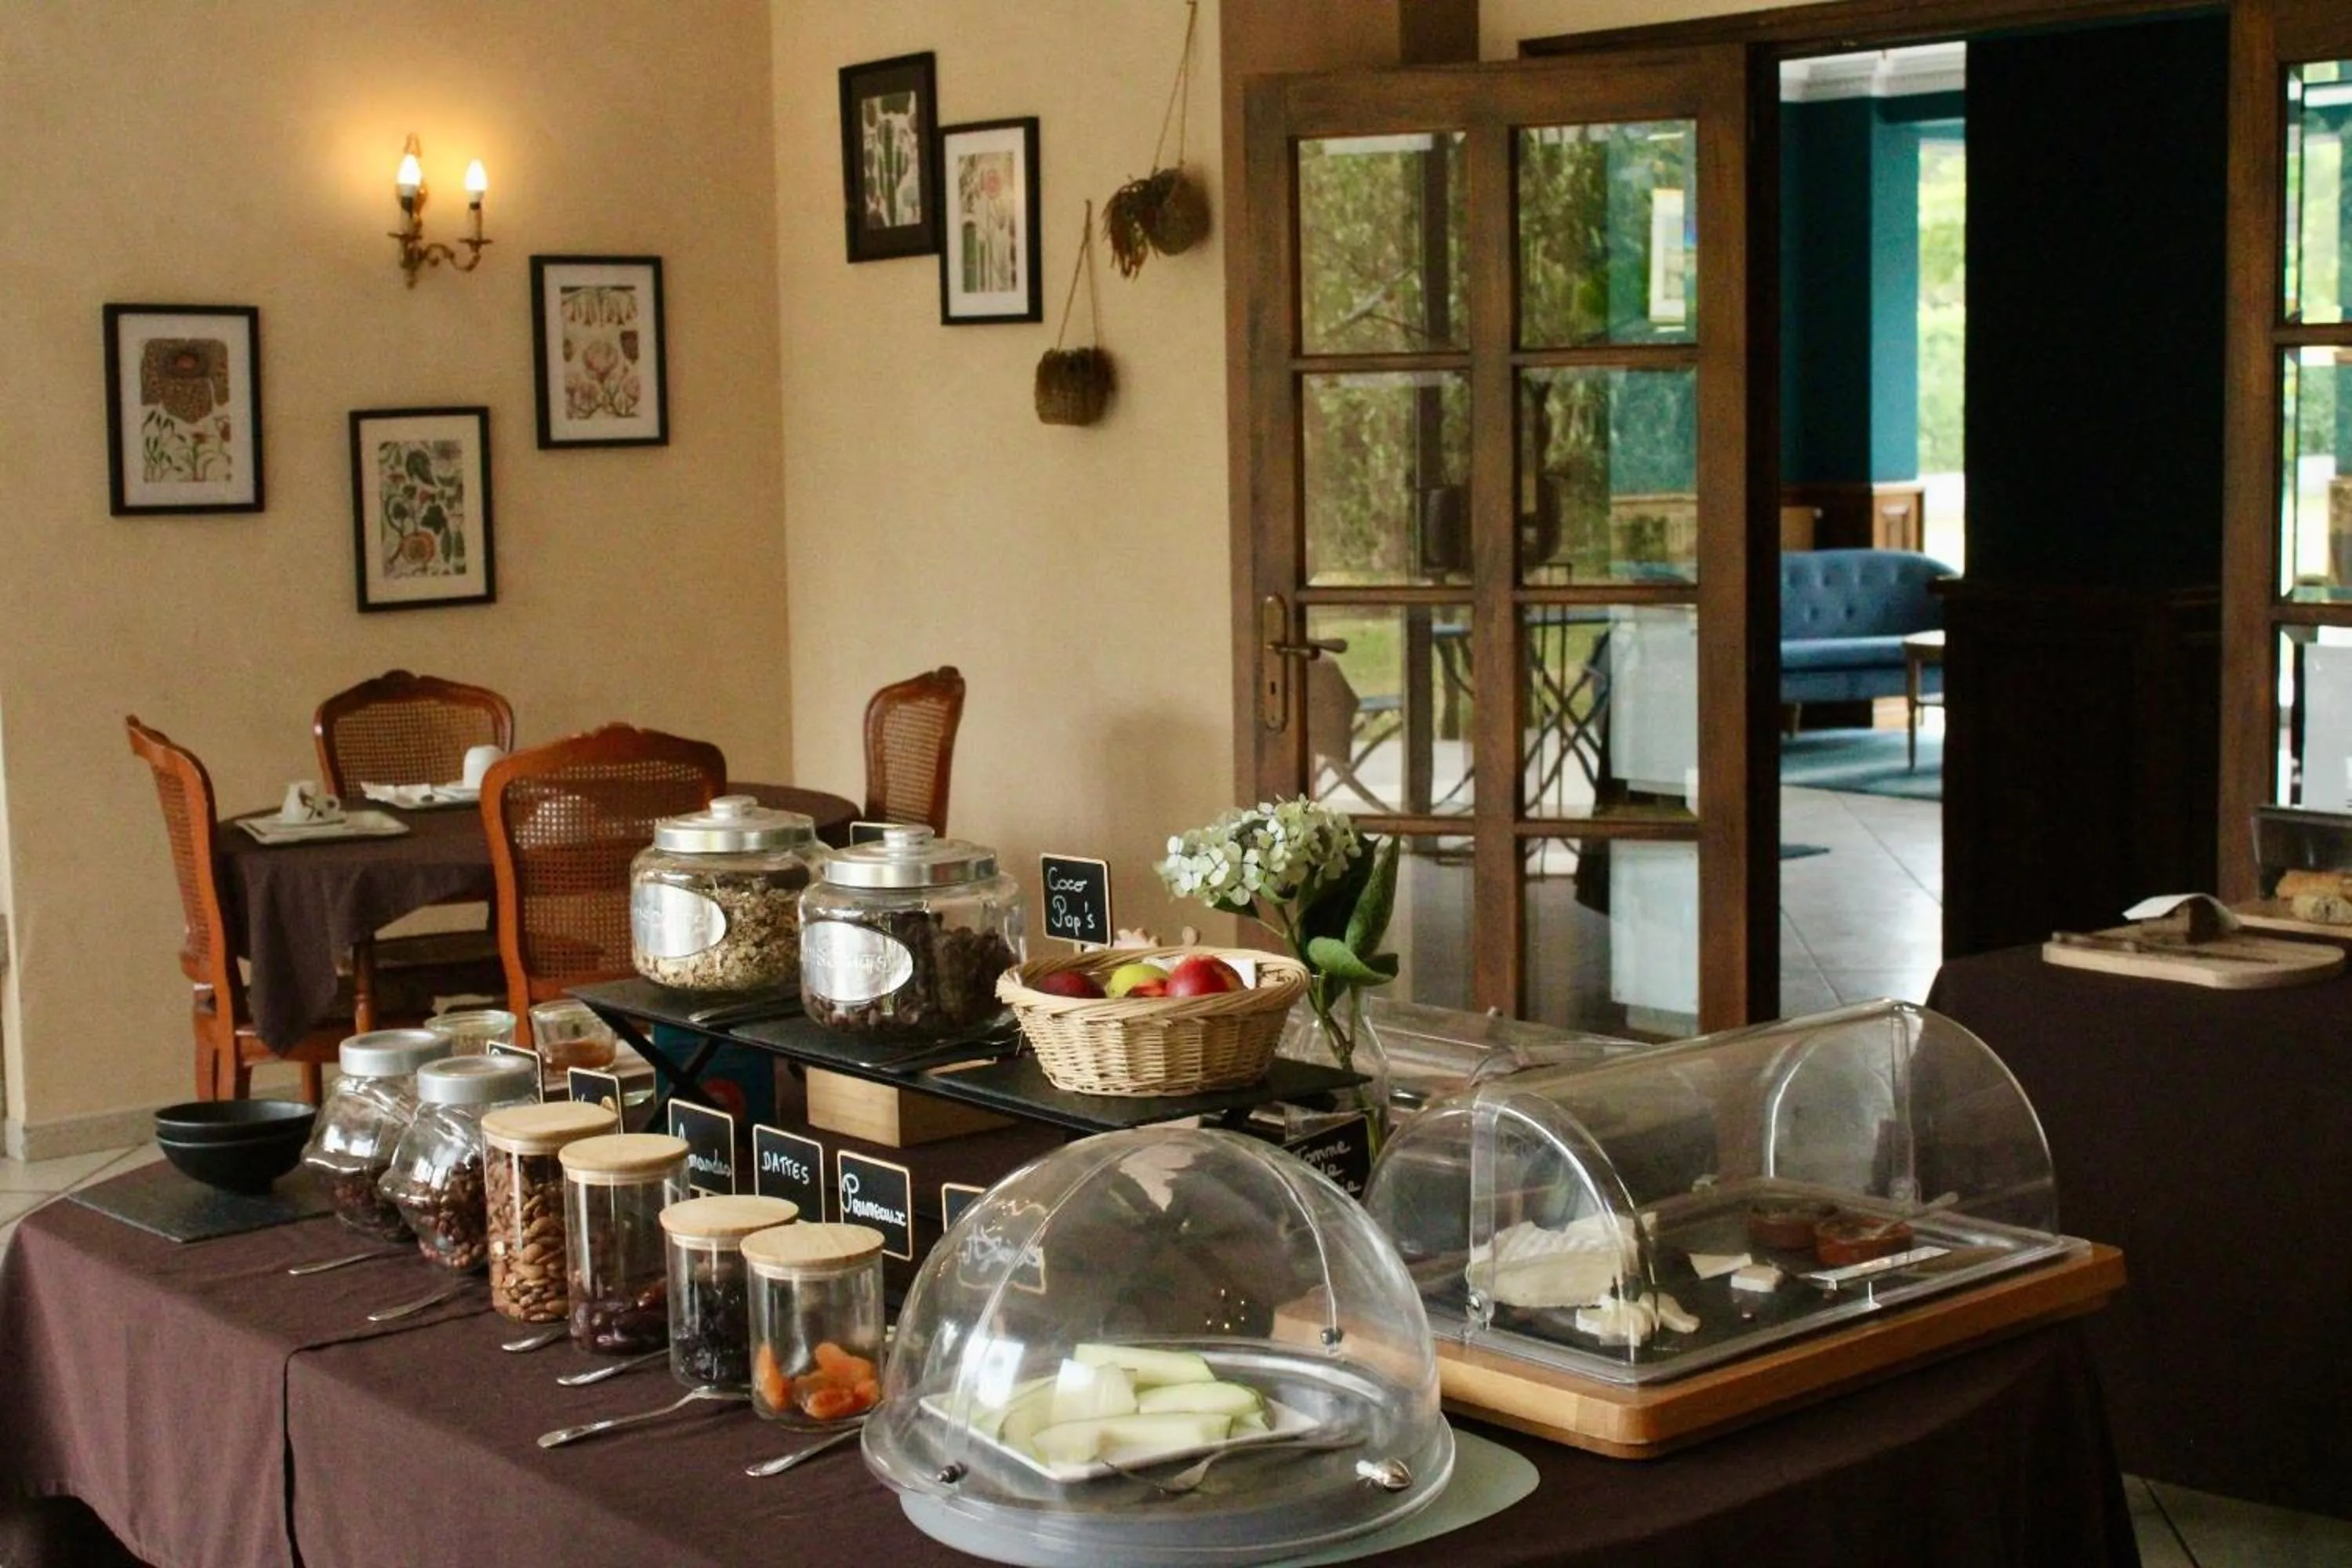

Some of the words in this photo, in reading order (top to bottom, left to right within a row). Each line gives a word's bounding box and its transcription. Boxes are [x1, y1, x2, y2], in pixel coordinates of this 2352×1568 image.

[1047, 866, 1087, 892] Coco
[1051, 895, 1095, 936] Pop's
[761, 1151, 809, 1185] DATTES
[1294, 1141, 1351, 1163] Tomme
[842, 1172, 907, 1227] Pruneaux
